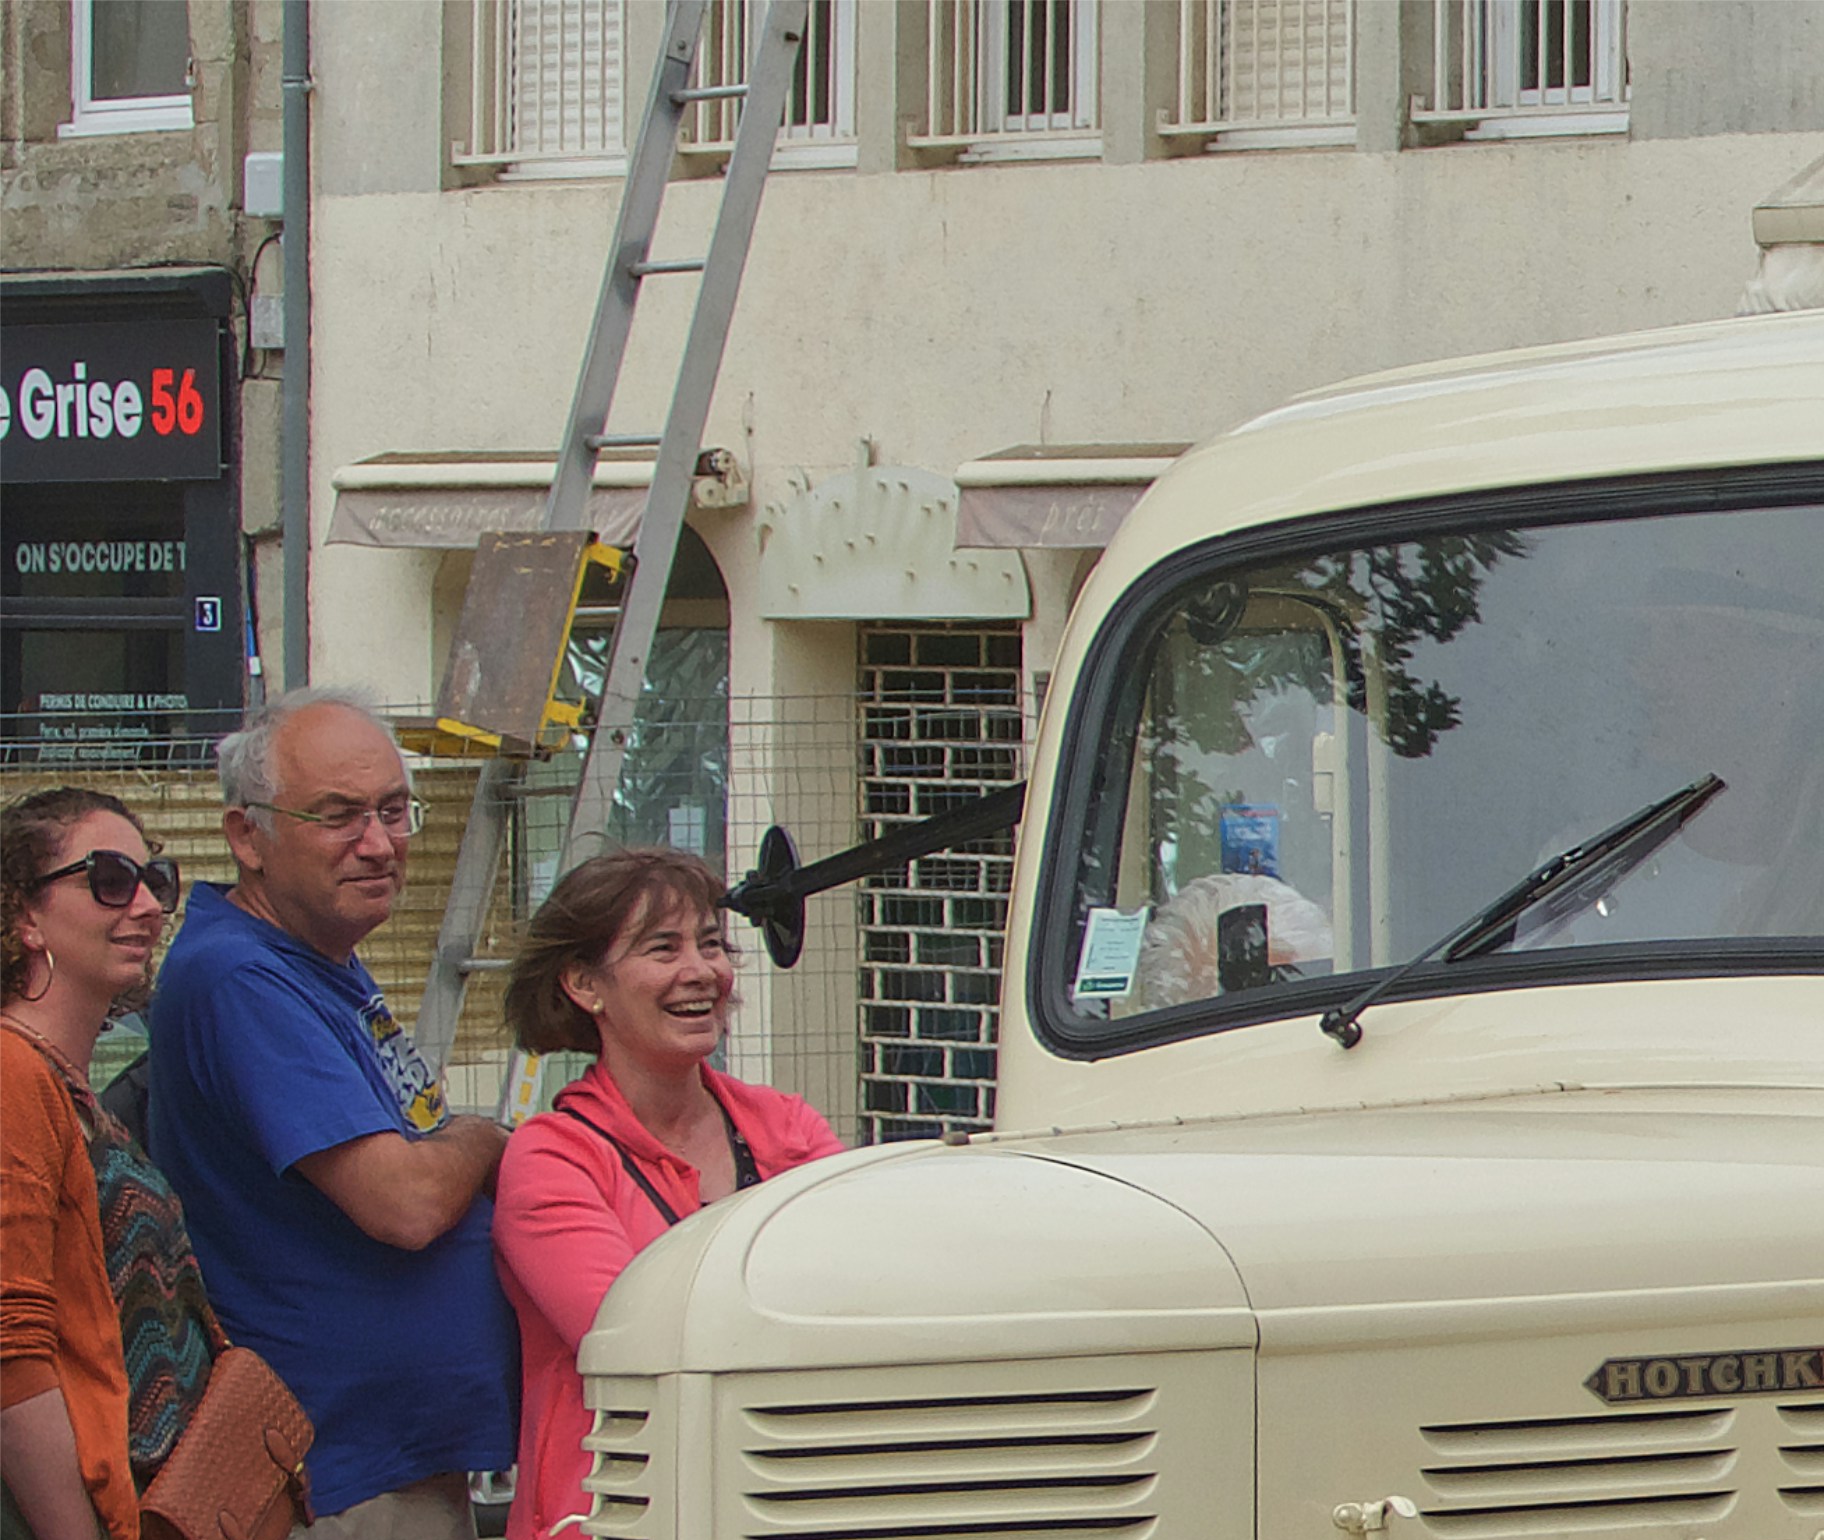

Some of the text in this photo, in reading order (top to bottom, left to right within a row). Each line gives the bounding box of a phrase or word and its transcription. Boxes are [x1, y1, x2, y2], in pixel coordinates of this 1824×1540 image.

[19, 361, 143, 440] Grise
[152, 368, 204, 435] 56
[16, 543, 45, 573] ON
[49, 541, 146, 573] S'OCCUPE
[150, 541, 174, 571] DE
[203, 603, 214, 625] 3
